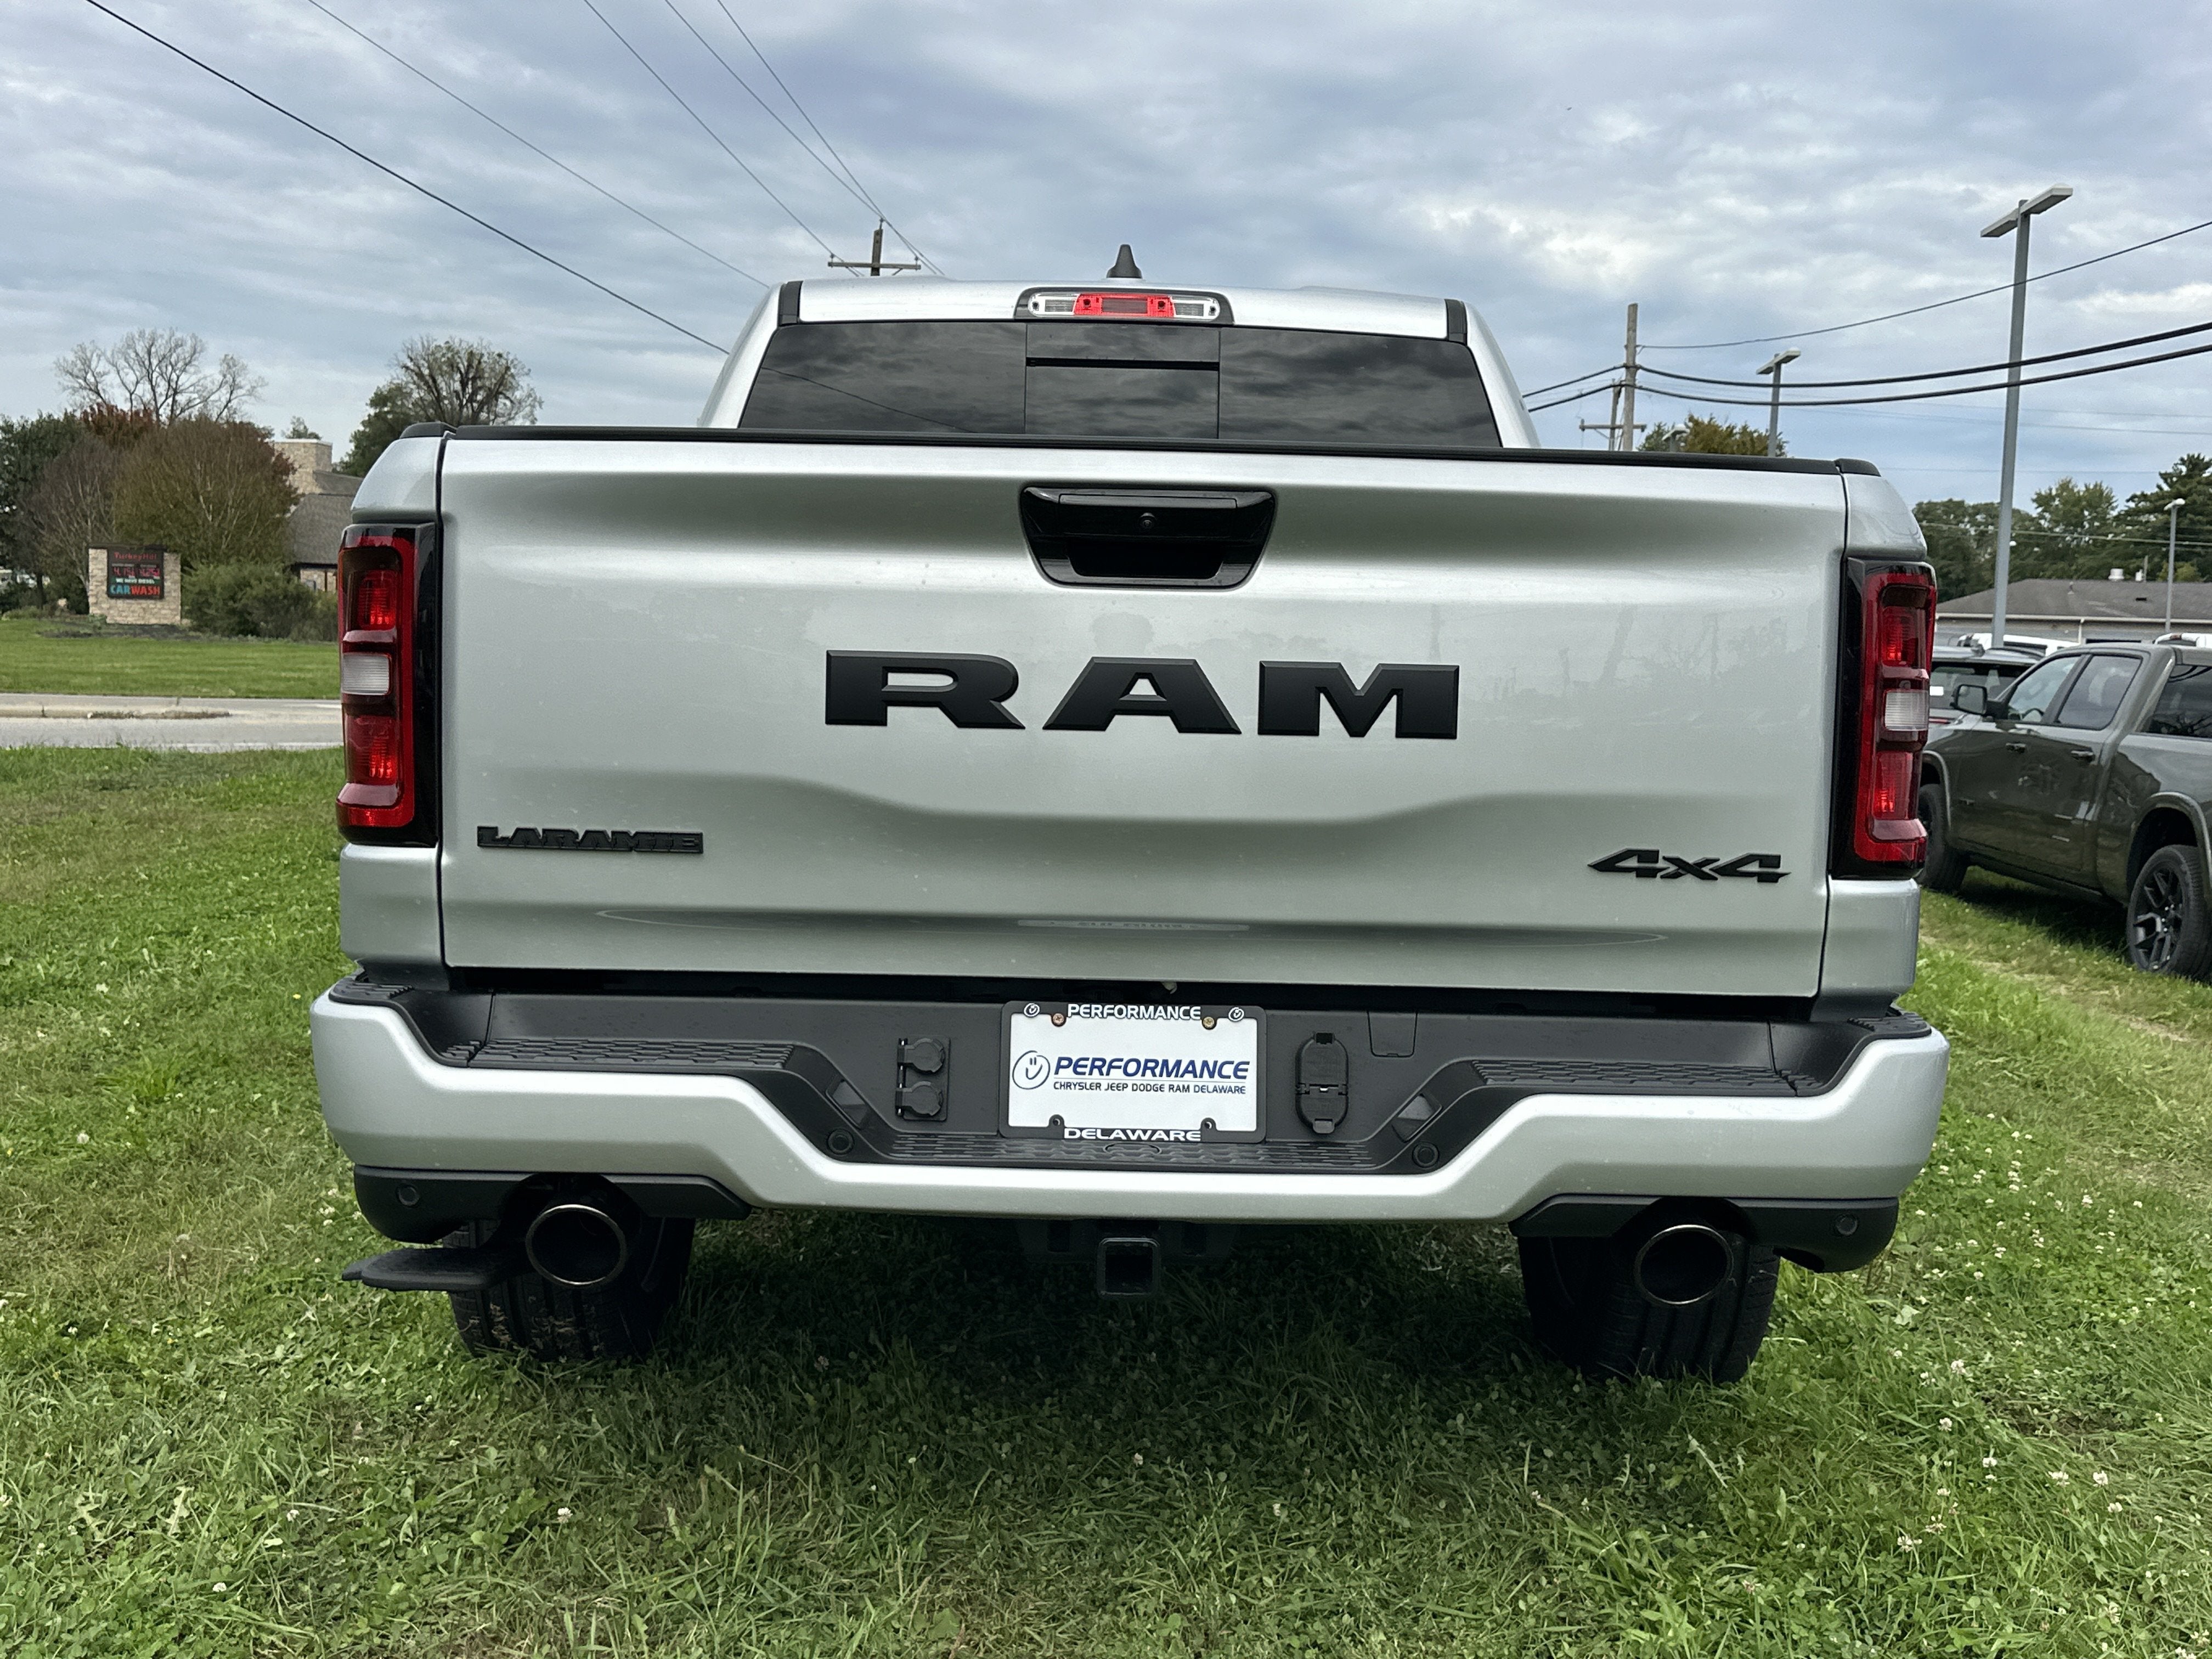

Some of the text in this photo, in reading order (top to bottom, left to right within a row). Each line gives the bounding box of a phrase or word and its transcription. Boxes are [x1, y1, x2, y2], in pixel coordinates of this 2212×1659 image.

[110, 584, 160, 595] CAR WASH
[825, 650, 1460, 740] RAM
[1068, 1003, 1201, 1020] PERFORMANCE
[1054, 1057, 1250, 1080] PERFORMANCE
[1053, 1081, 1246, 1094] CHRYSLER JEEP DODGE RAM DELAWARE
[1064, 1128, 1201, 1142] DELAWARE
